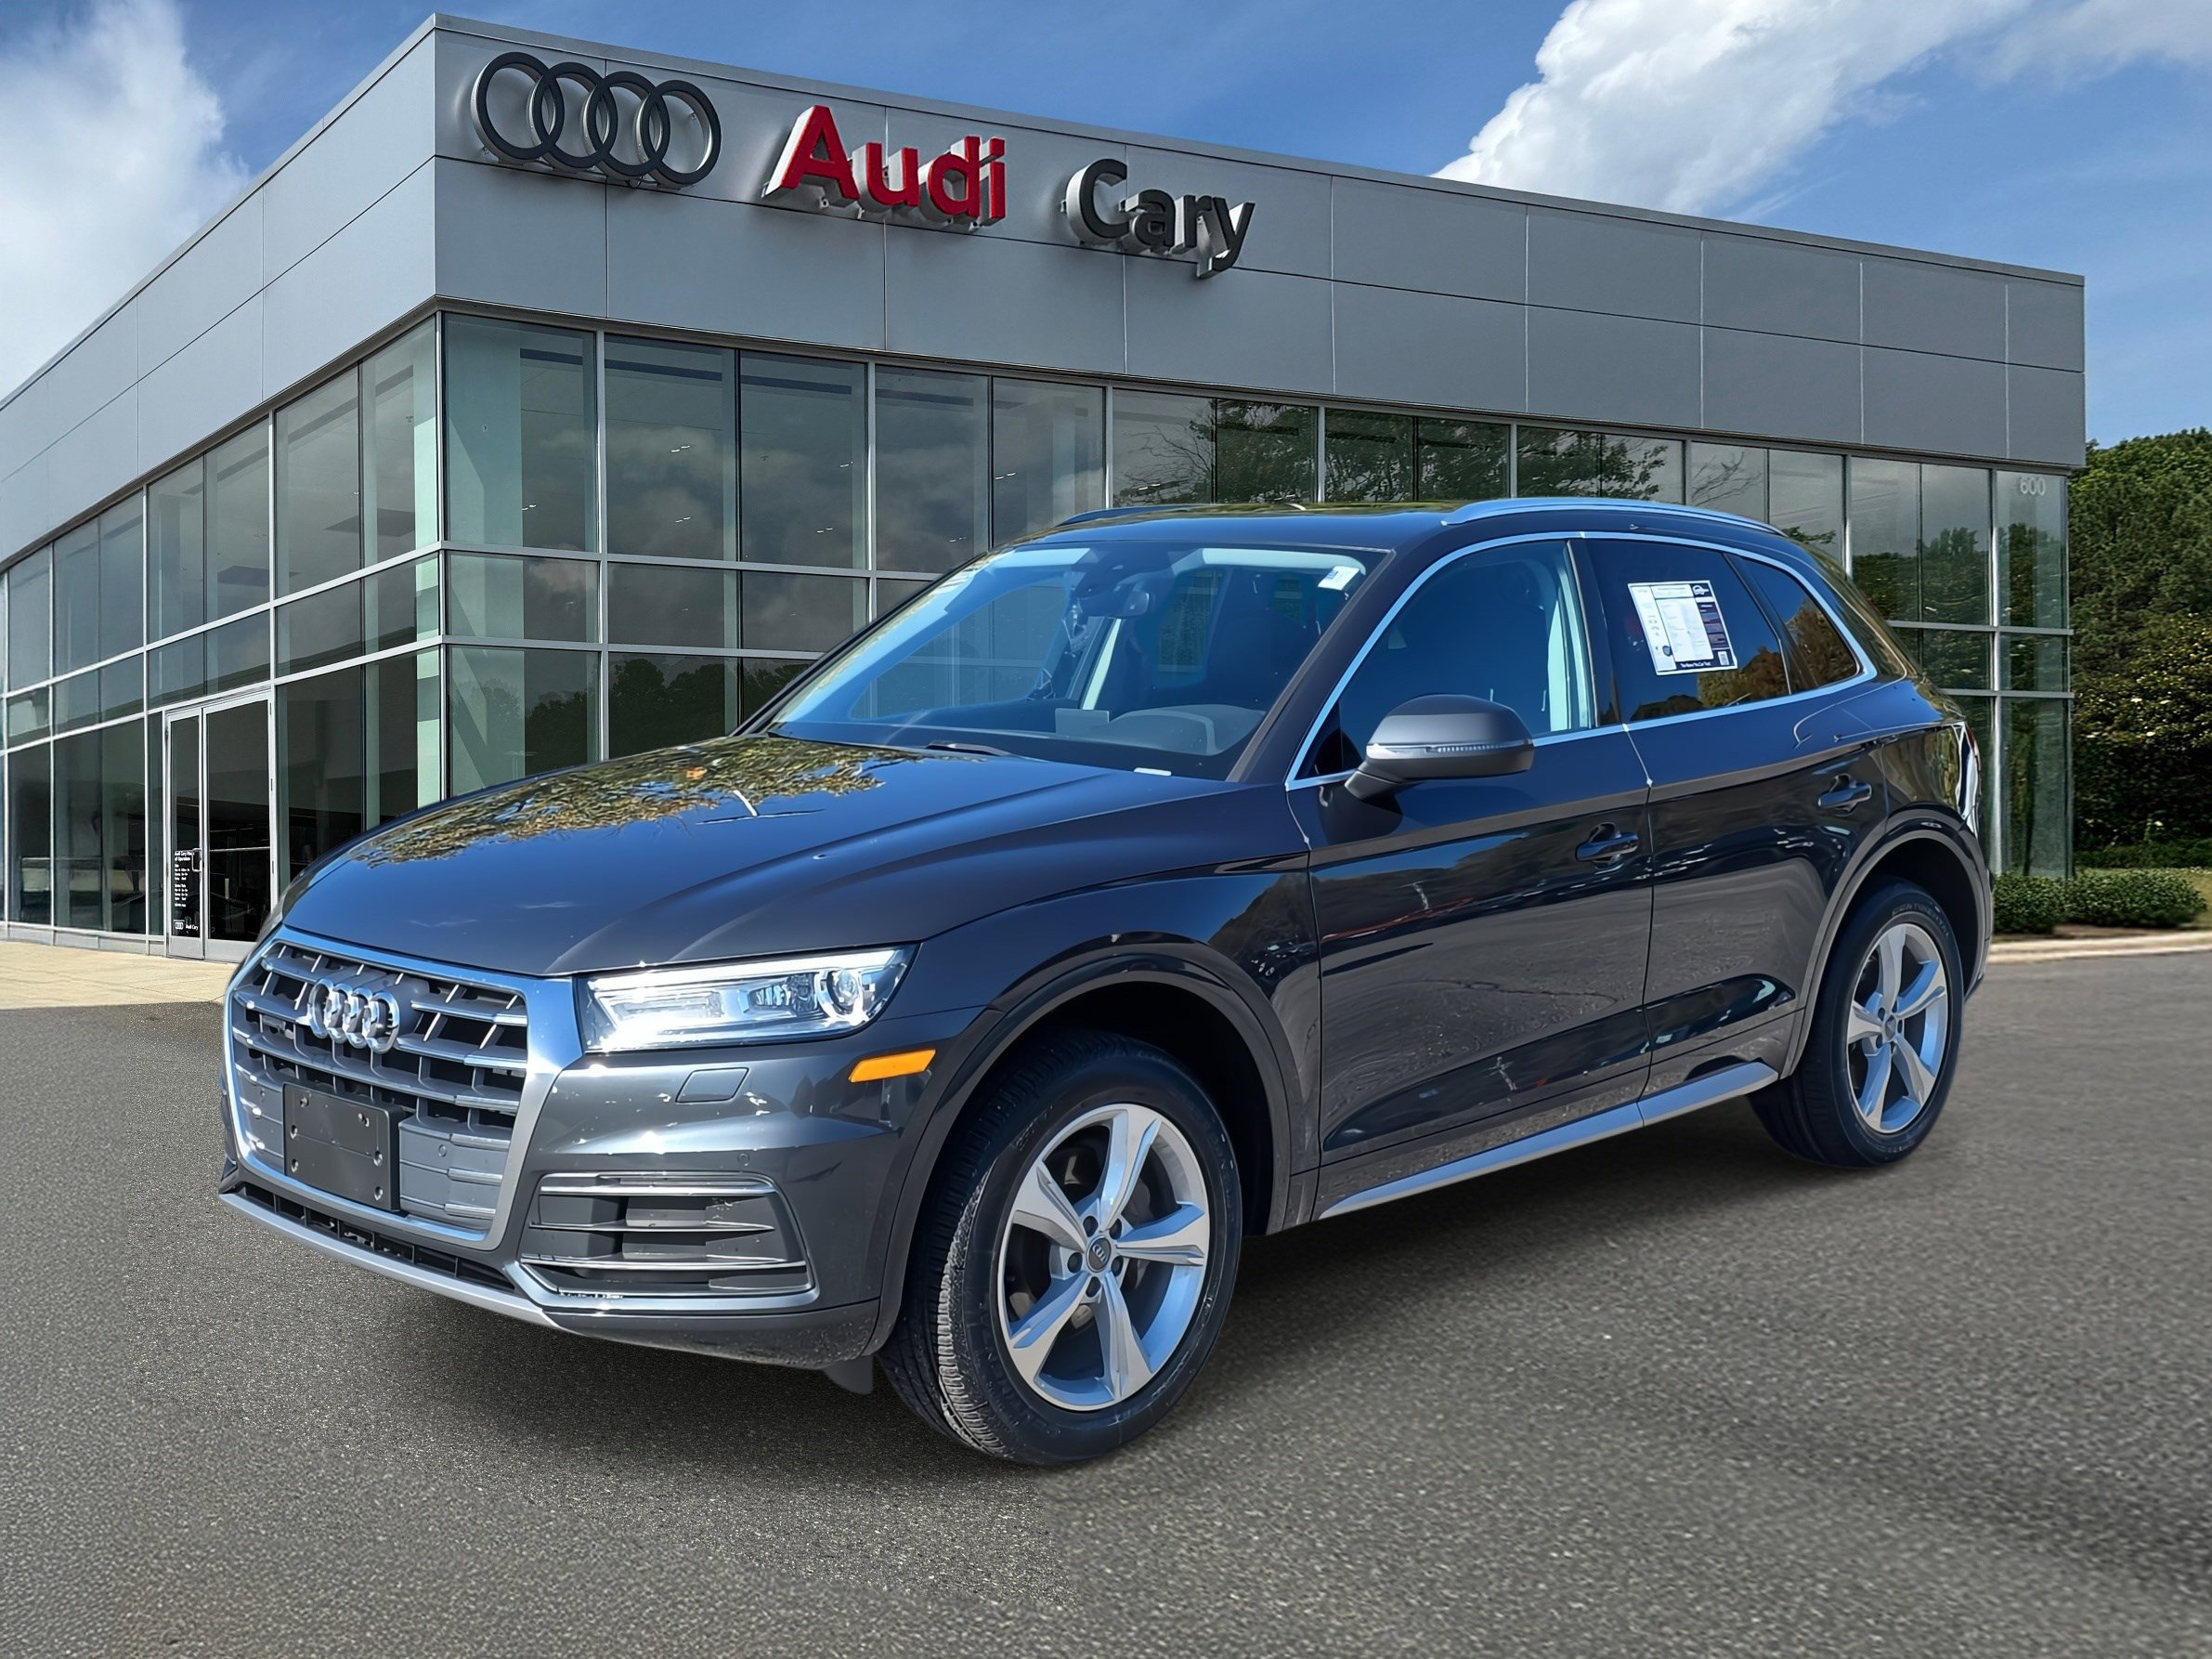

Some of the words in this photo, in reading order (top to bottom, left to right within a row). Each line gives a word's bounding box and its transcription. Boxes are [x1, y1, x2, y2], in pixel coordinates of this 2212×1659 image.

[763, 104, 1007, 225] Audi
[1064, 158, 1256, 279] Cary
[2020, 477, 2046, 496] 600
